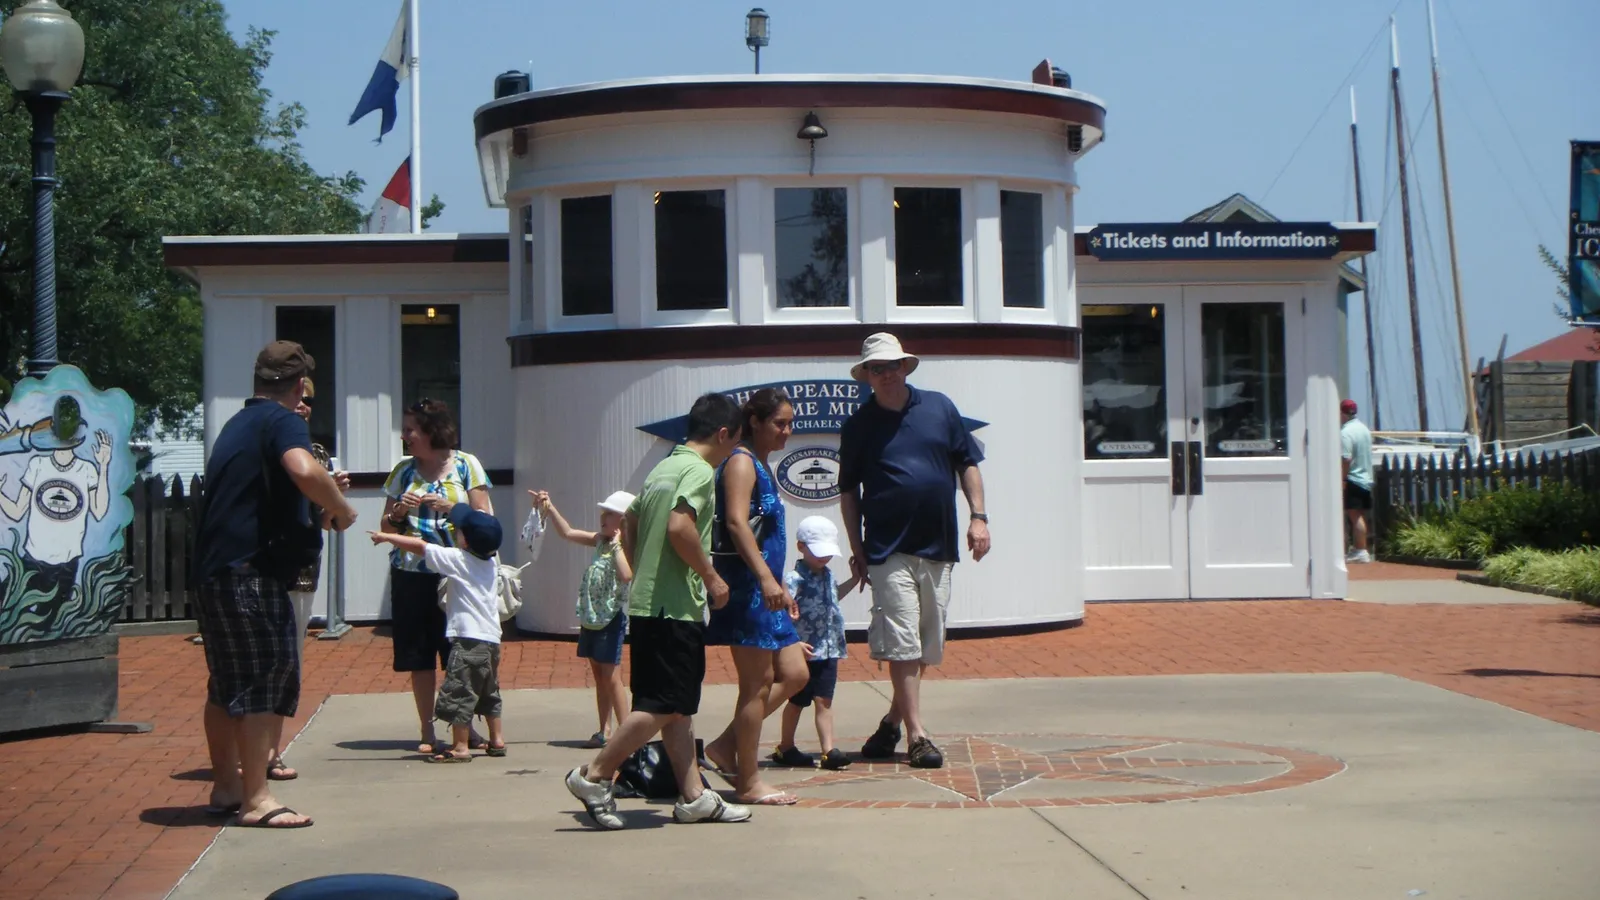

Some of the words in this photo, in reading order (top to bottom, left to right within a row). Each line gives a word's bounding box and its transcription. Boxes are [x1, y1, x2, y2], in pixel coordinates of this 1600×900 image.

[1575, 223, 1600, 235] Che
[1102, 232, 1167, 249] Tickets
[1172, 231, 1209, 248] and
[1215, 231, 1327, 248] Information
[791, 420, 842, 430] ICHAELS
[783, 449, 834, 467] CHESAPEAKE
[781, 478, 818, 498] MARITIME
[820, 486, 841, 498] MUSE
